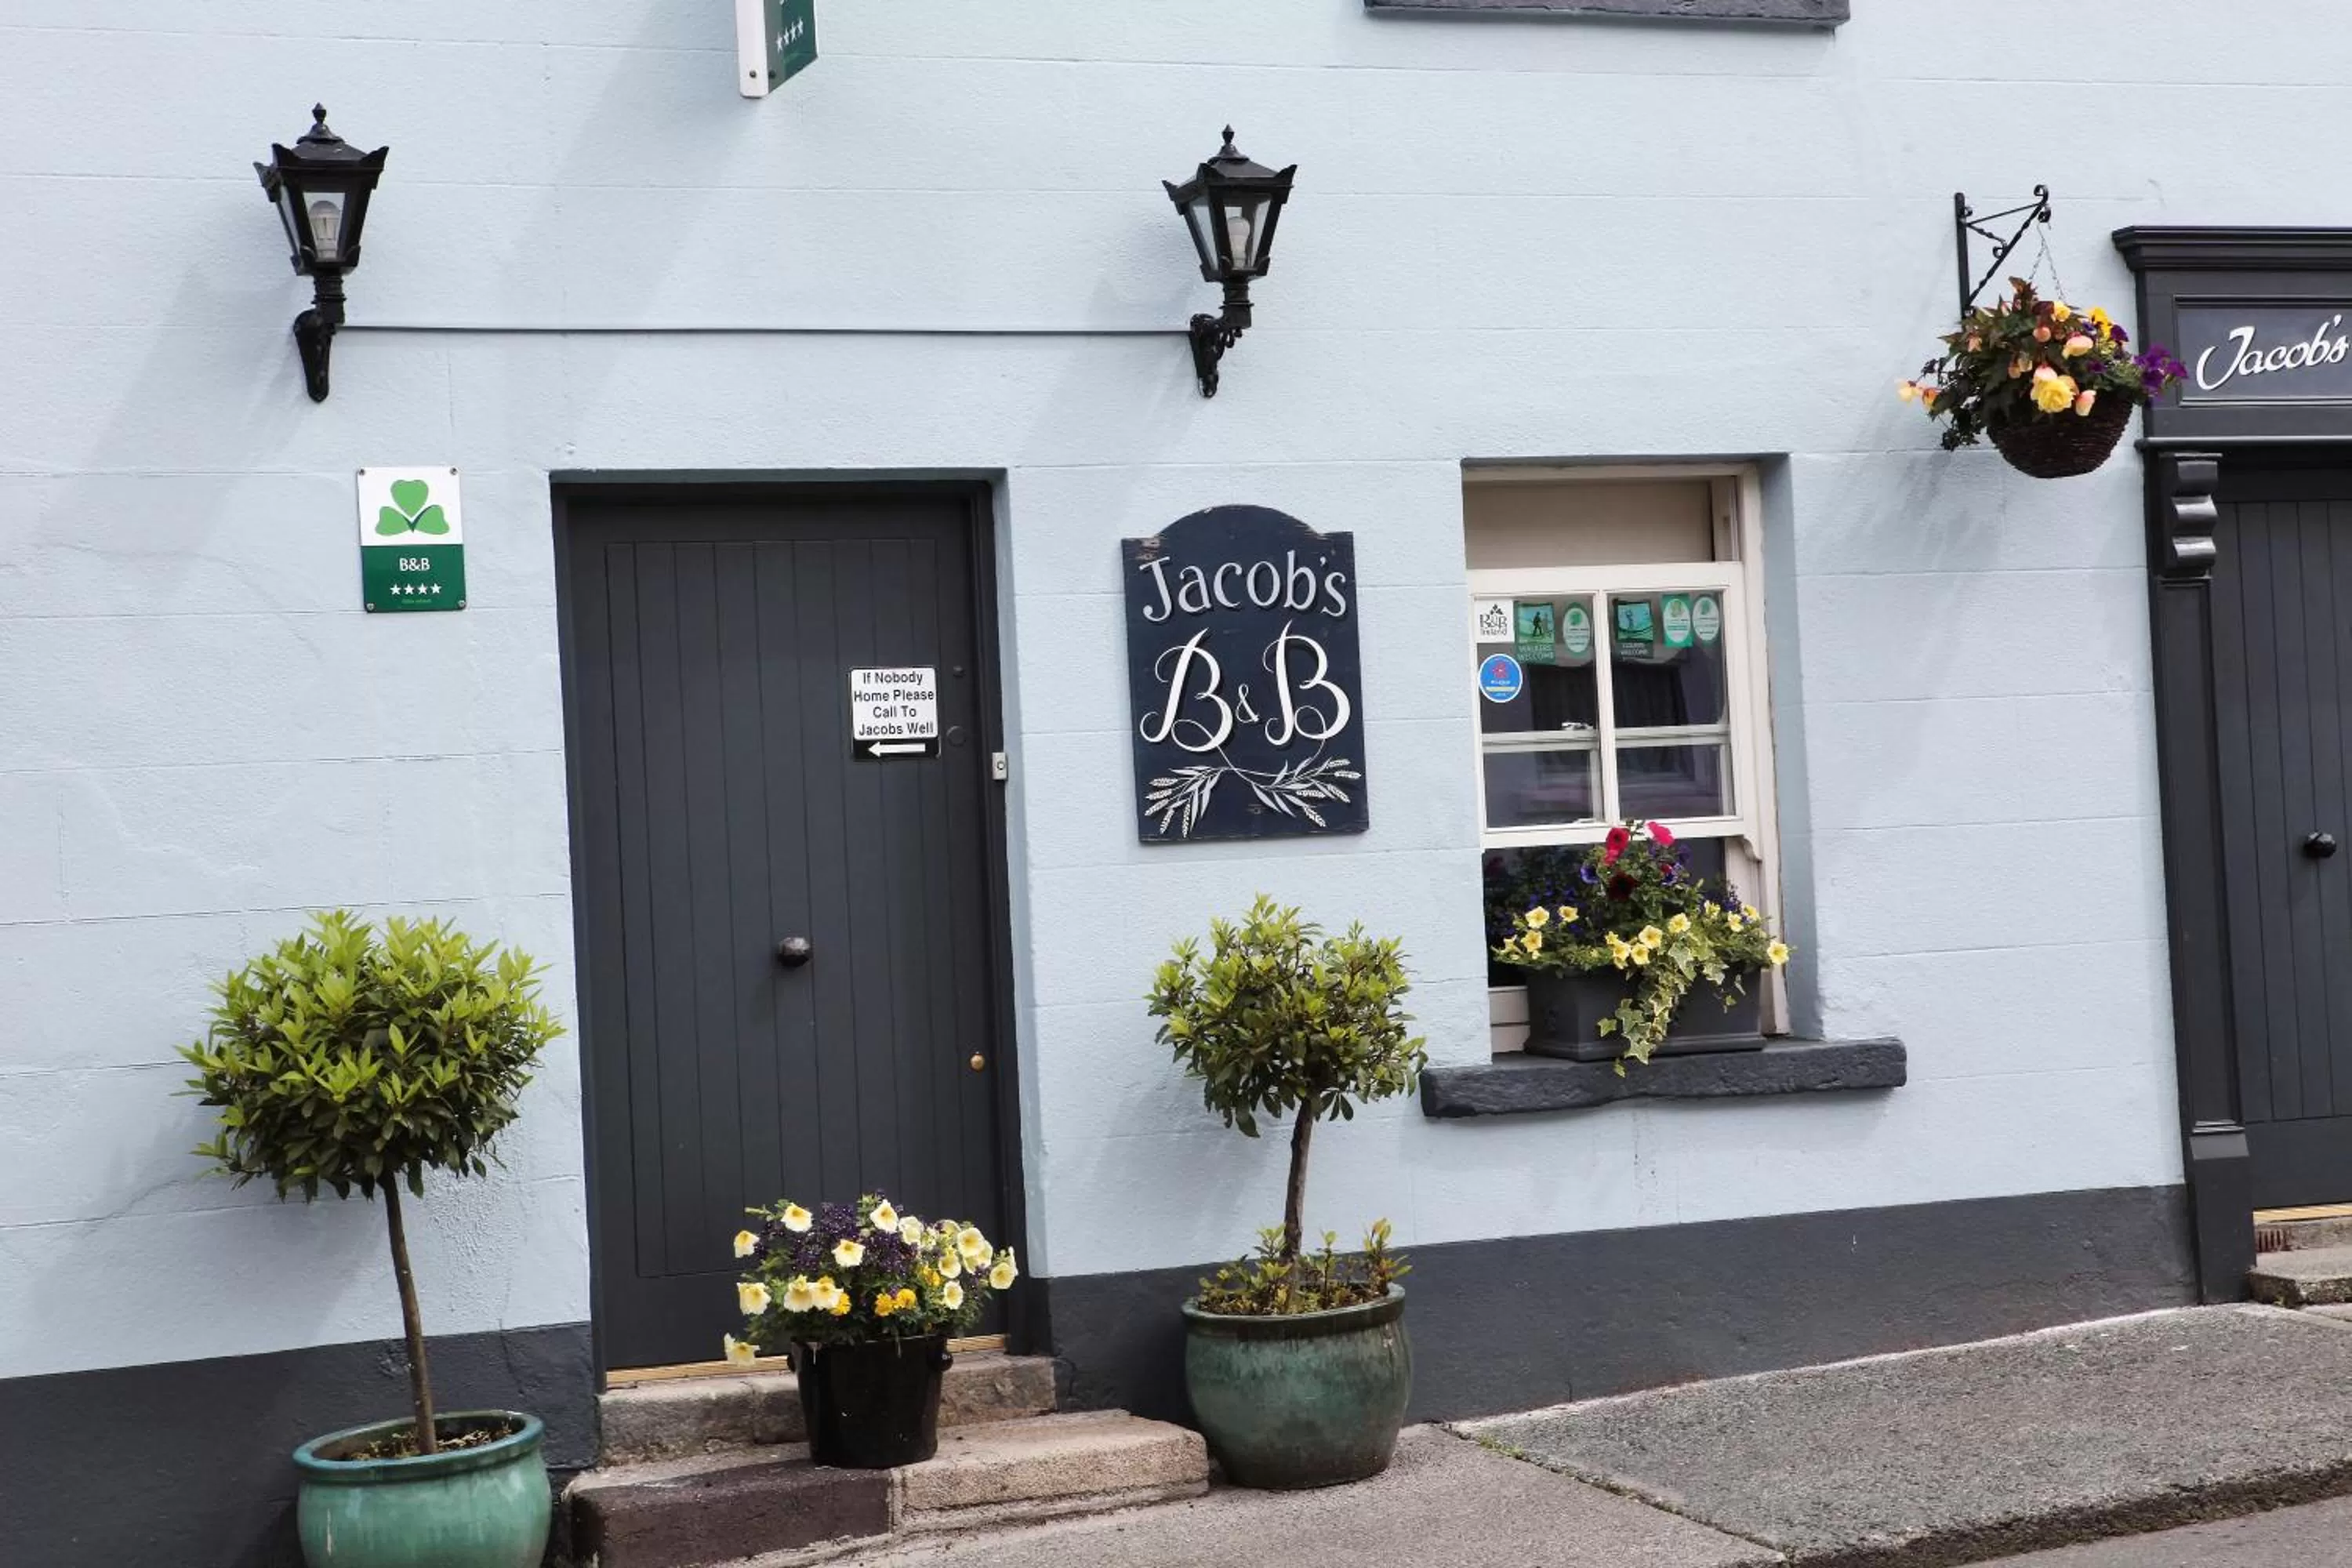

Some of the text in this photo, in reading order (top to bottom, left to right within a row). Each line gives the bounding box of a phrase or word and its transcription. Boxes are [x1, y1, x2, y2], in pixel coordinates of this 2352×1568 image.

[2196, 314, 2349, 390] Jacob's
[399, 557, 430, 572] B&B
[1139, 550, 1347, 622] Jacob's
[863, 672, 923, 685] If Nobody
[854, 689, 935, 702] Home Please
[873, 706, 916, 718] Call To
[858, 722, 934, 735] Jacobs Well
